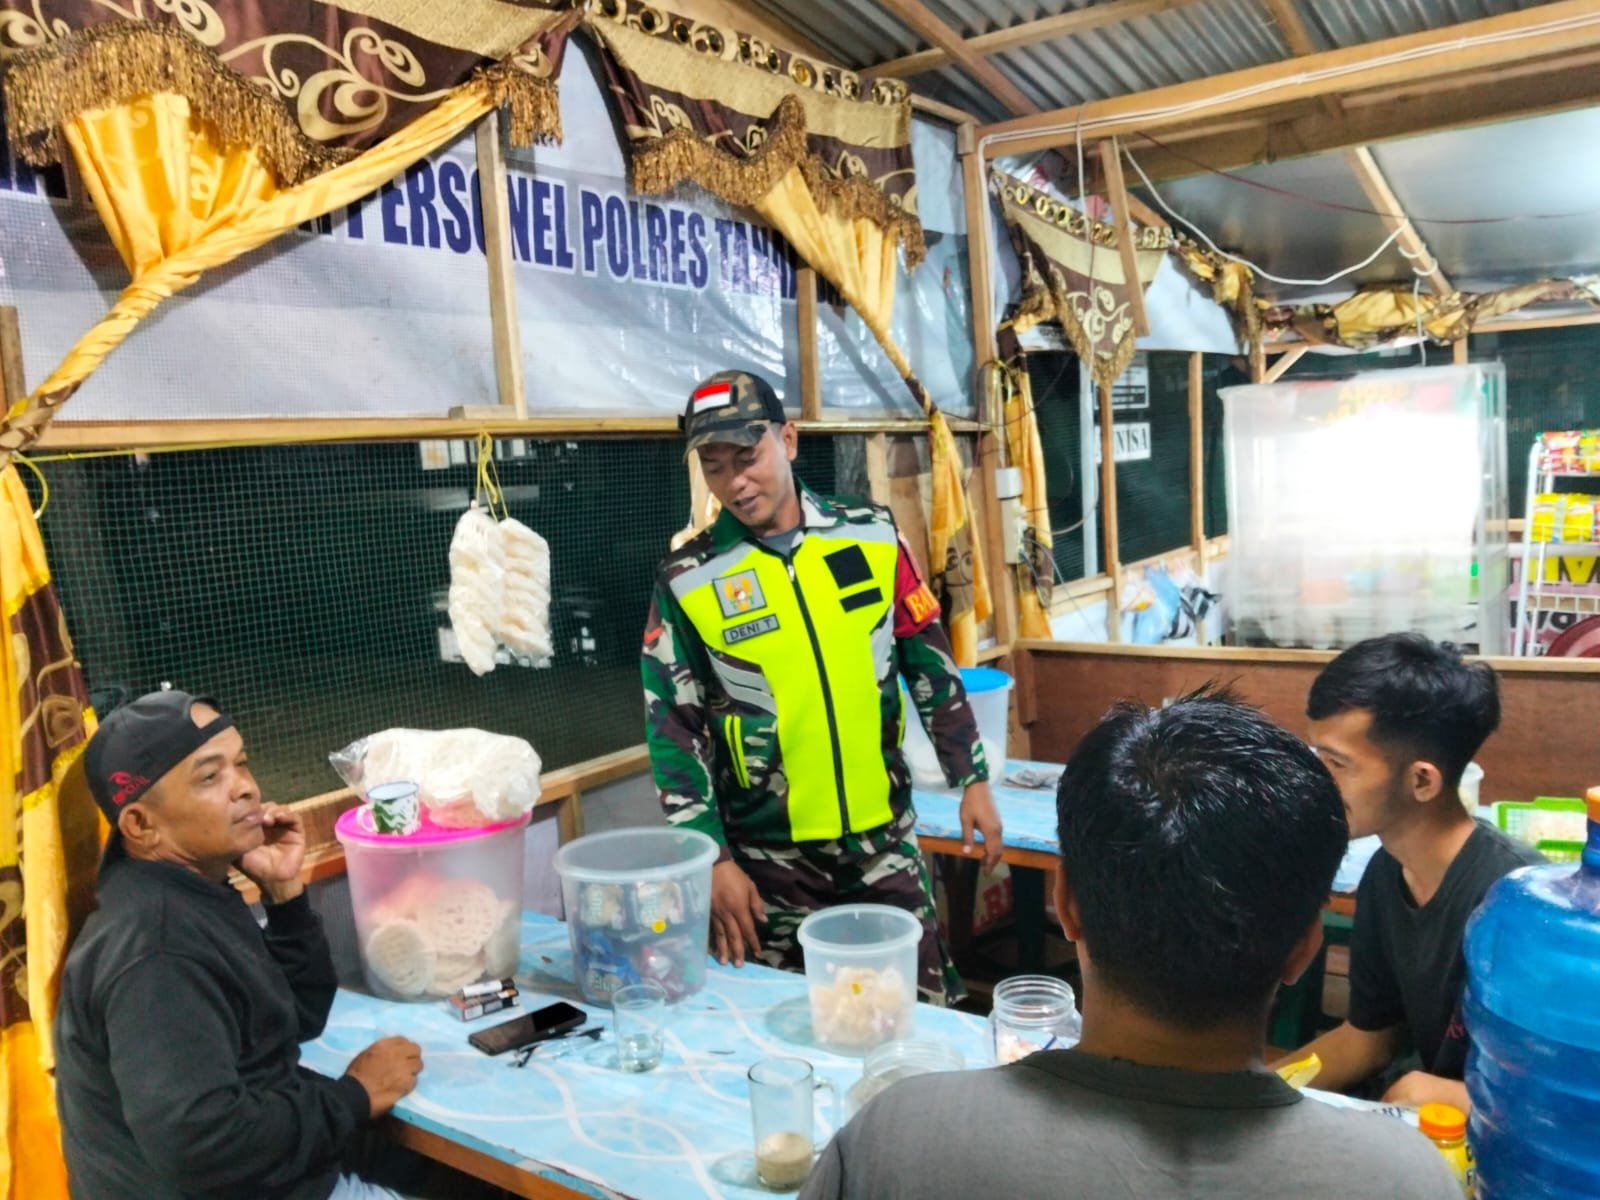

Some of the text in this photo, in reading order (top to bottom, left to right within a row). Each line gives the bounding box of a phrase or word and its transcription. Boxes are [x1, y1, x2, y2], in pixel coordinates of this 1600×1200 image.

[581, 189, 708, 289] POLRES
[730, 618, 771, 640] DENI T
